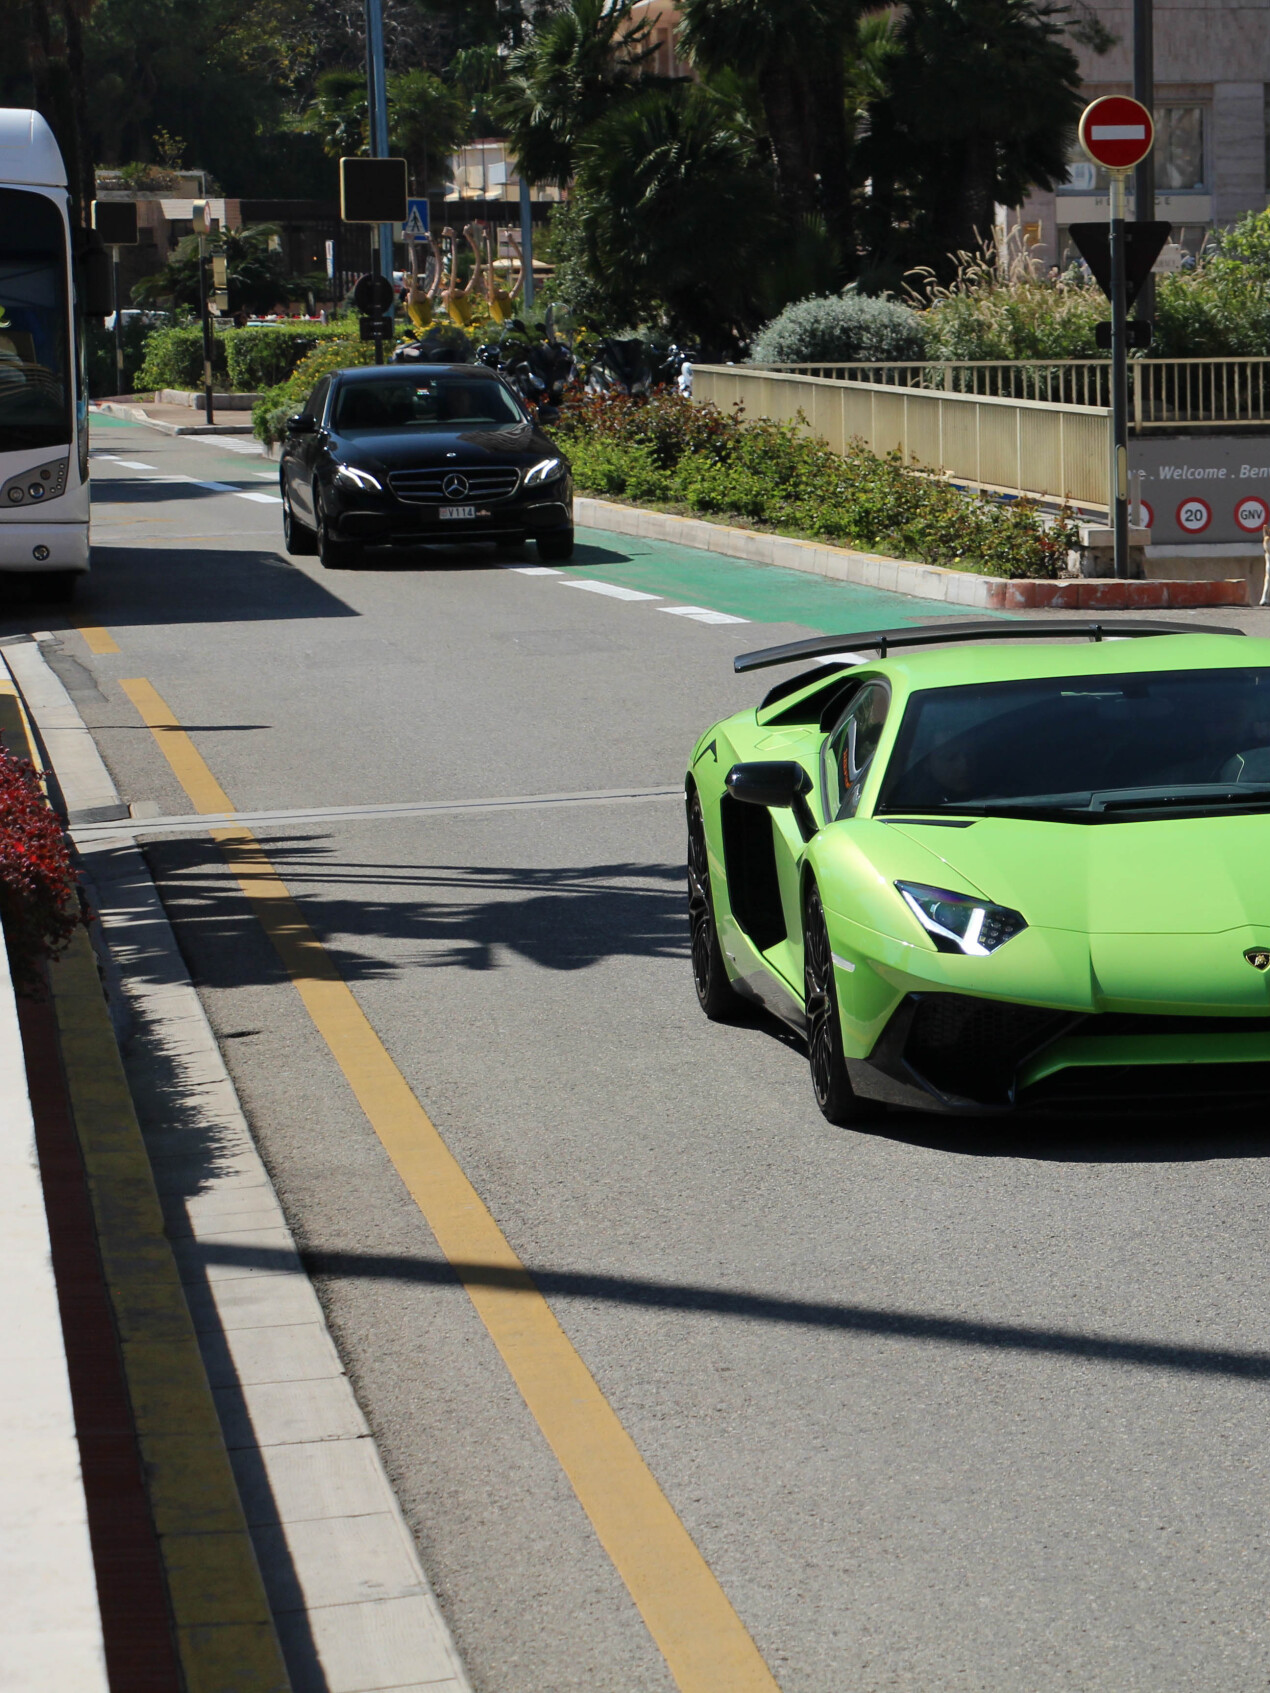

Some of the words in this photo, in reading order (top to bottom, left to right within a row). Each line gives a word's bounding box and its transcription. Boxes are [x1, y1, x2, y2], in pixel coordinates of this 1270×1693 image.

[1159, 465, 1227, 480] Welcome
[448, 507, 473, 517] V114
[1184, 509, 1203, 522] 20
[1240, 509, 1263, 521] GNV
